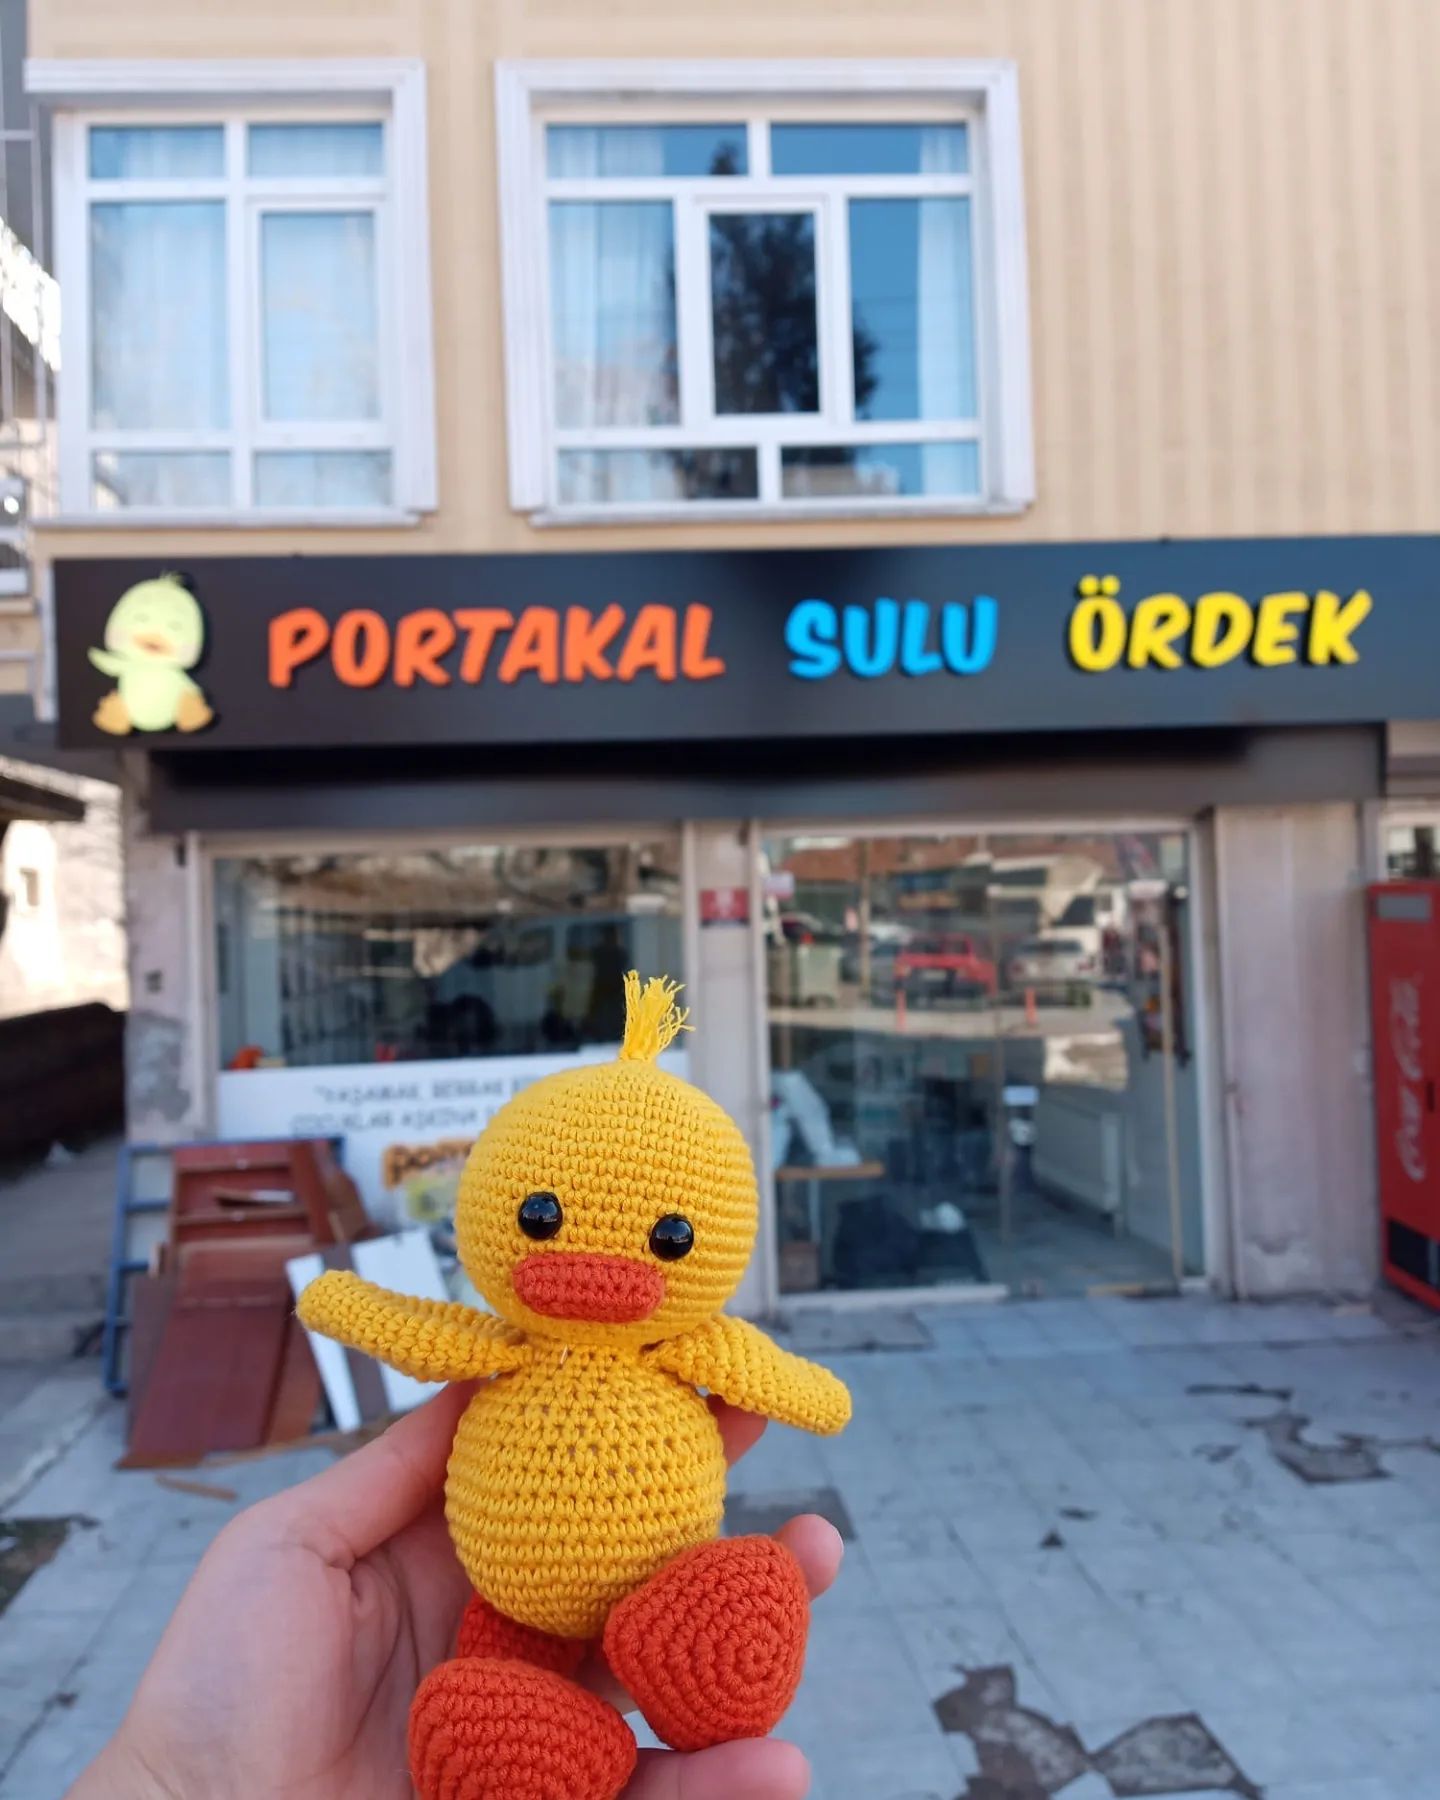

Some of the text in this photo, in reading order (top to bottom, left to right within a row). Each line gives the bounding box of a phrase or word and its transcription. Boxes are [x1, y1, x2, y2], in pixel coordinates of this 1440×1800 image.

[268, 575, 1372, 687] PORTAKAL SULU ÖRDEK
